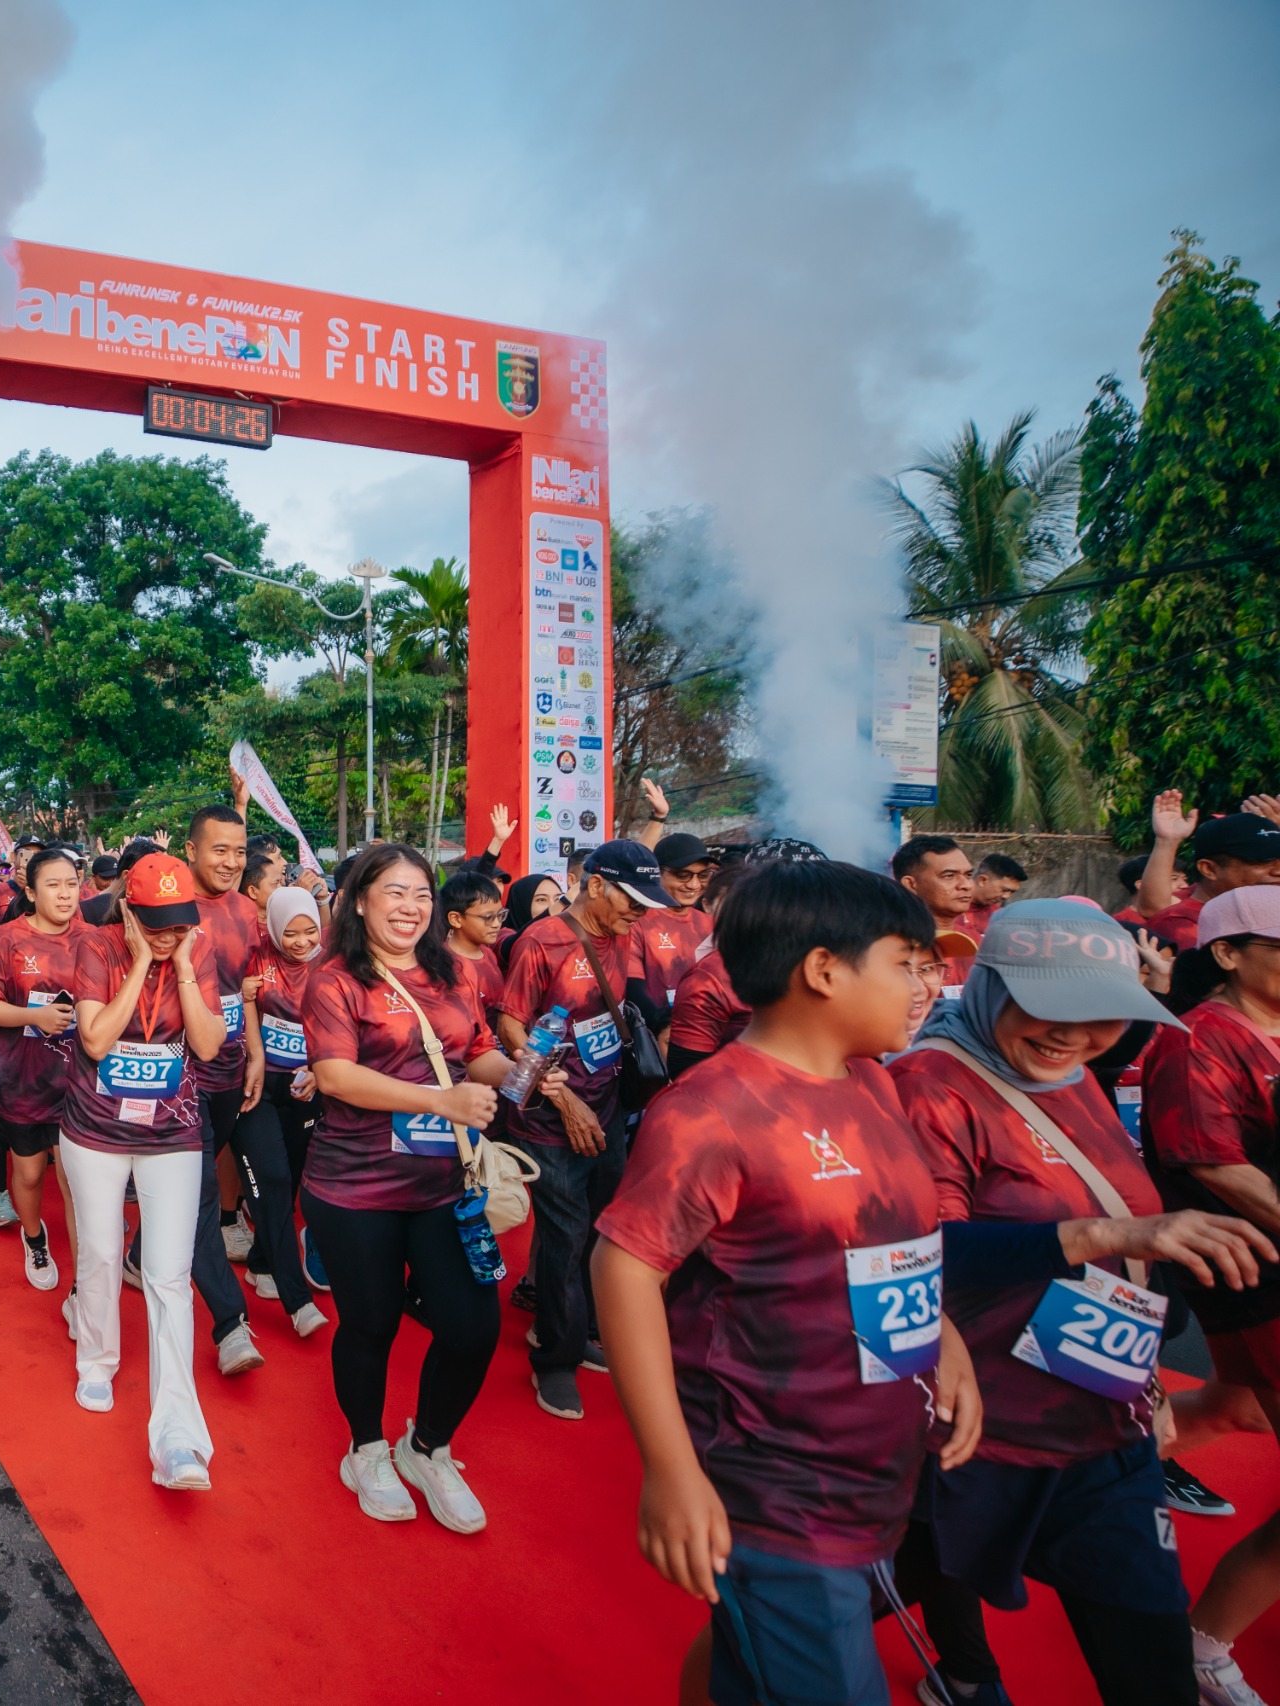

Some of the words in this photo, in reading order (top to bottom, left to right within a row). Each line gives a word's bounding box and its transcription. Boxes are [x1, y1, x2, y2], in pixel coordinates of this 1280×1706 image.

[327, 317, 476, 369] START
[97, 343, 129, 355] BEING
[131, 347, 188, 363] EXCELLENT
[191, 356, 229, 369] NOTARY
[231, 362, 280, 377] EVERYDAY
[282, 369, 301, 380] RUN
[325, 349, 479, 402] FINISH
[152, 393, 267, 442] 00:04:26
[545, 570, 564, 583] BNI
[575, 576, 597, 588] UOB
[600, 866, 620, 876] SUZUKI
[108, 1058, 173, 1081] 2397
